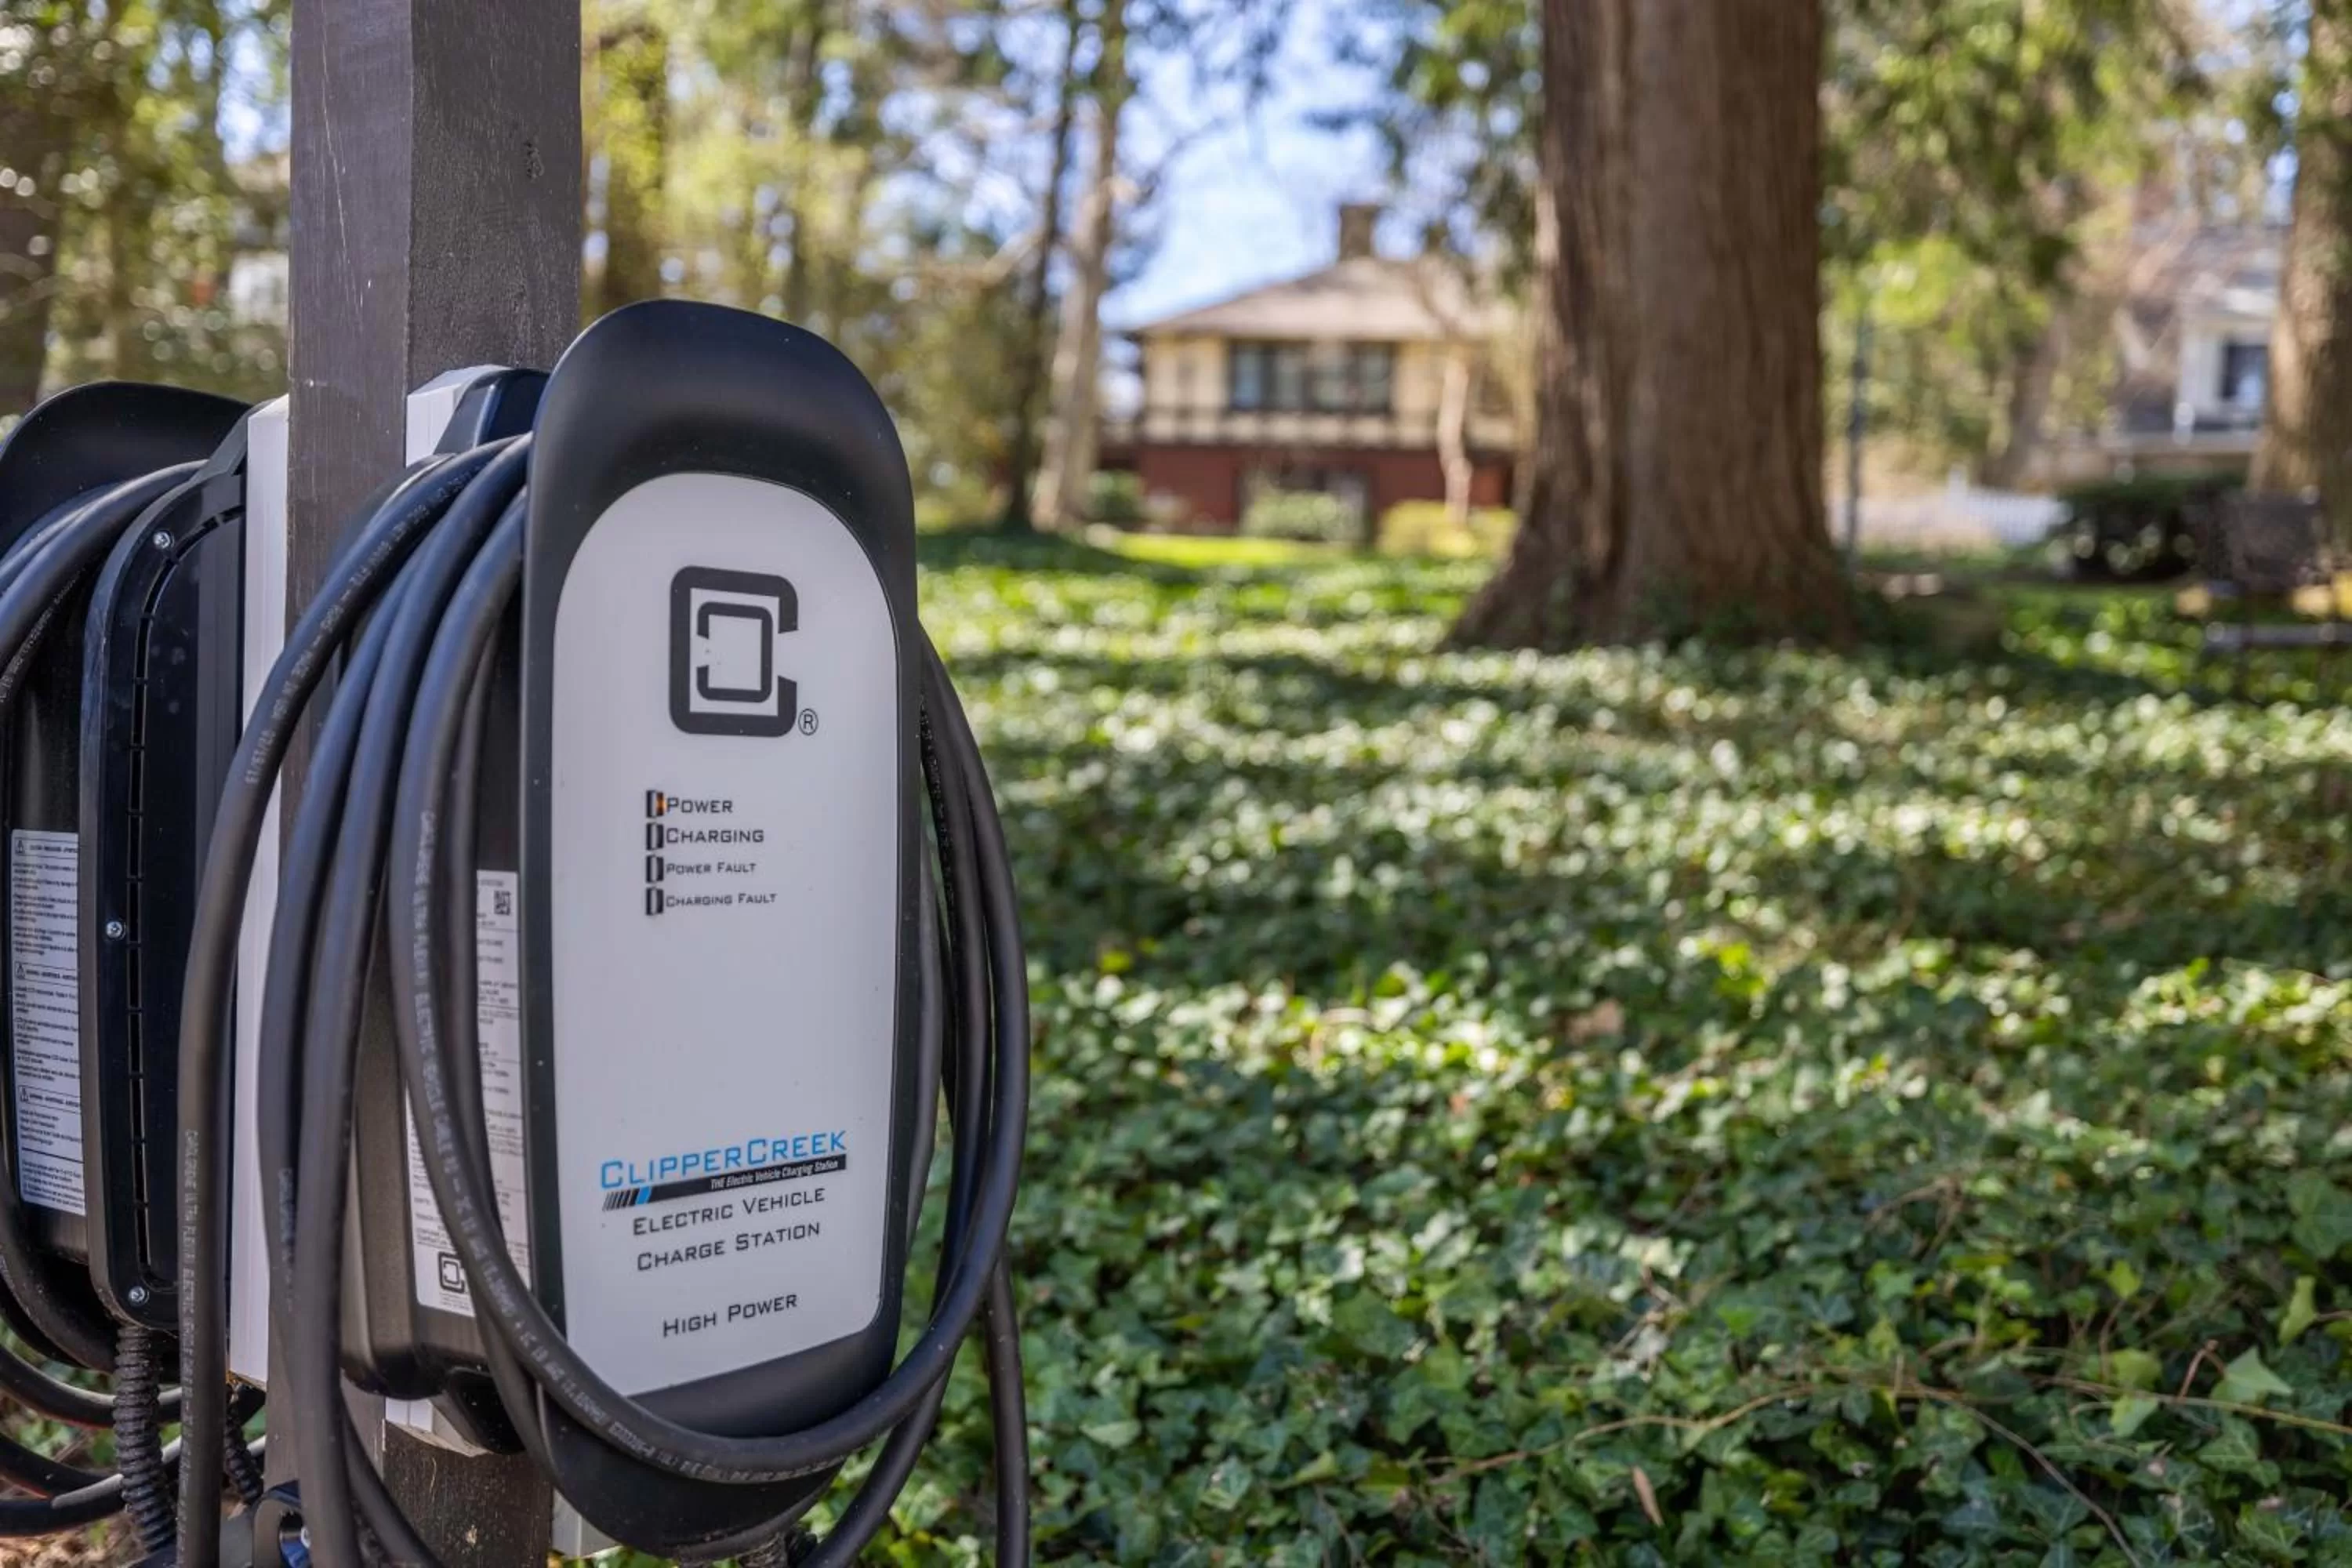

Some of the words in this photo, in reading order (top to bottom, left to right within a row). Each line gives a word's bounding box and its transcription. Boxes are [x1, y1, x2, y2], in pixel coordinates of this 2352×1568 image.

[666, 797, 733, 814] POWER
[666, 828, 764, 844] CHARGING
[666, 862, 711, 875] POWER
[717, 862, 757, 874] FAULT
[666, 895, 733, 908] CHARGING
[739, 893, 776, 906] FAULT
[601, 1131, 847, 1189] CLIPPERCREEK
[710, 1178, 725, 1190] THE
[726, 1174, 753, 1187] Electric
[755, 1169, 782, 1182] Vehicle
[782, 1164, 814, 1178] Charging
[815, 1160, 839, 1173] Station
[633, 1204, 733, 1236] ELECTRIC
[743, 1189, 826, 1214] VEHICLE
[637, 1240, 725, 1272] CHARGE
[735, 1222, 820, 1252] STATION
[662, 1312, 717, 1338] HIGH
[728, 1294, 797, 1323] POWER
